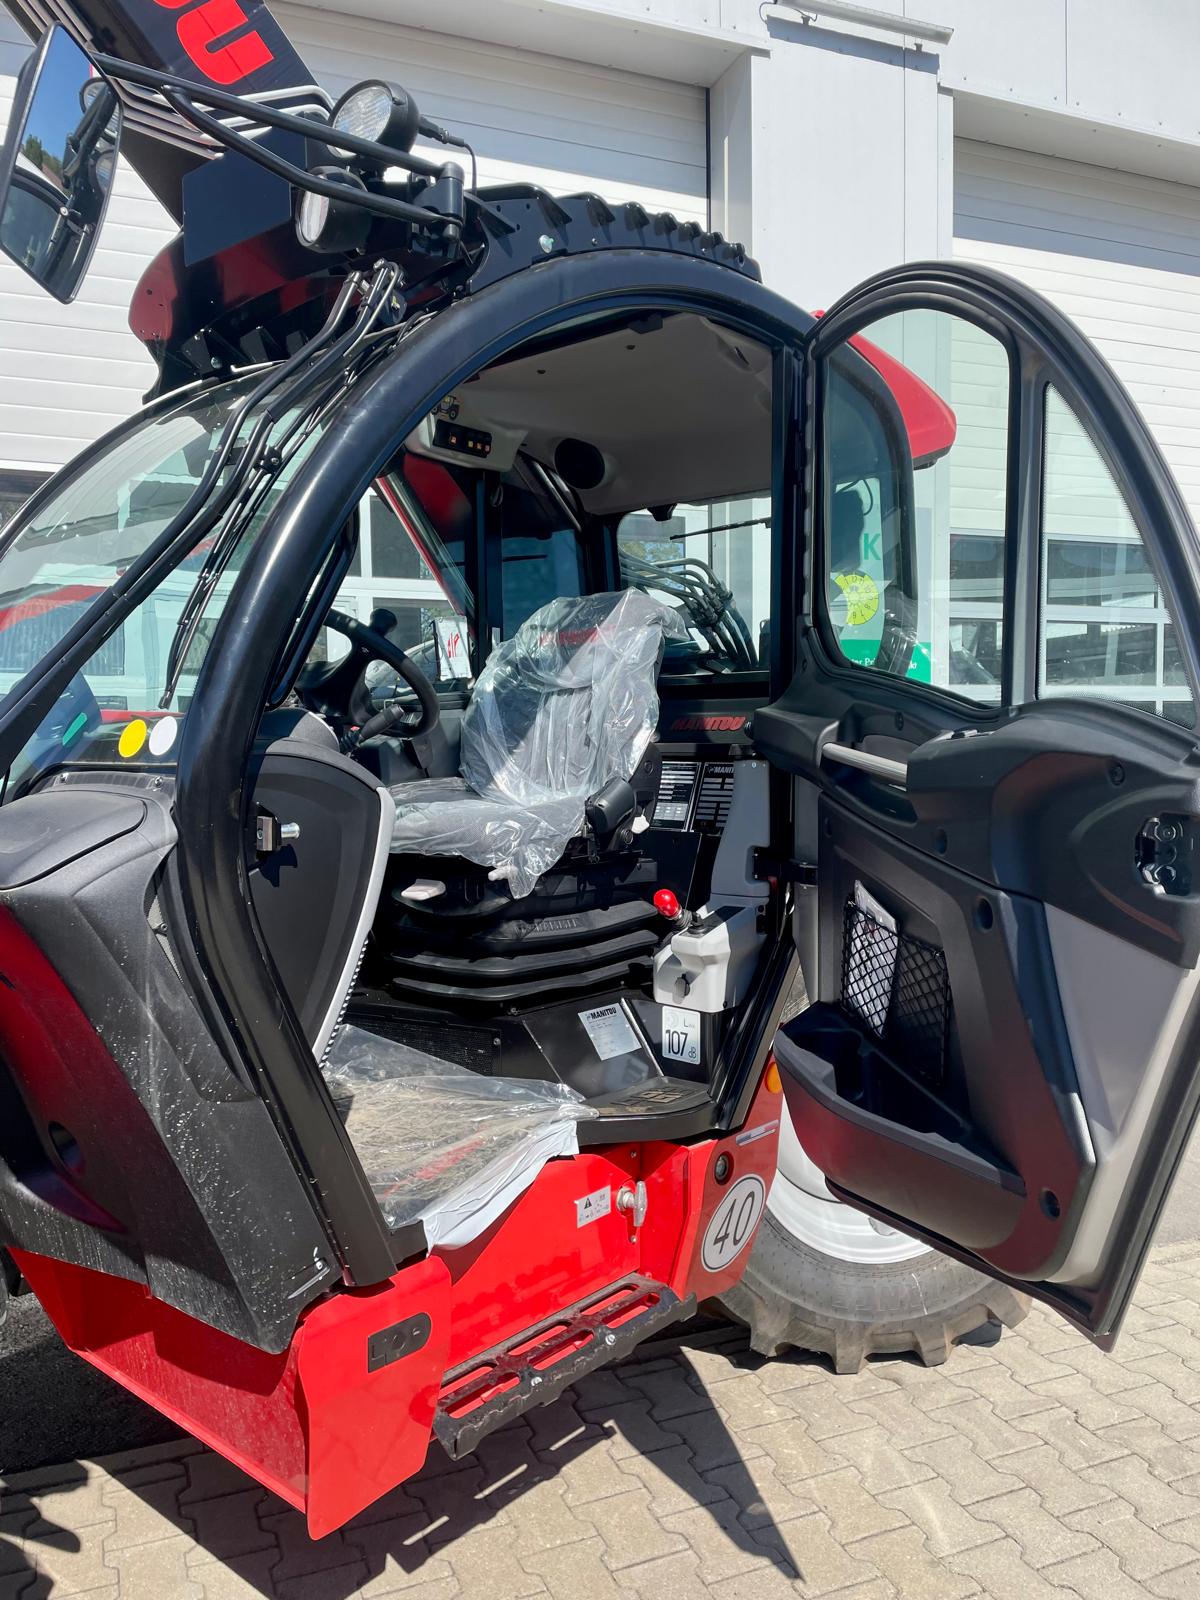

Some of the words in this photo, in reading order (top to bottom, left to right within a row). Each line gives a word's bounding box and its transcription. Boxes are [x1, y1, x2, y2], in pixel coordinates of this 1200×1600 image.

[672, 716, 746, 731] MANITOU
[590, 1007, 617, 1020] MANITOU
[665, 1029, 689, 1057] 107
[713, 1190, 755, 1254] 40
